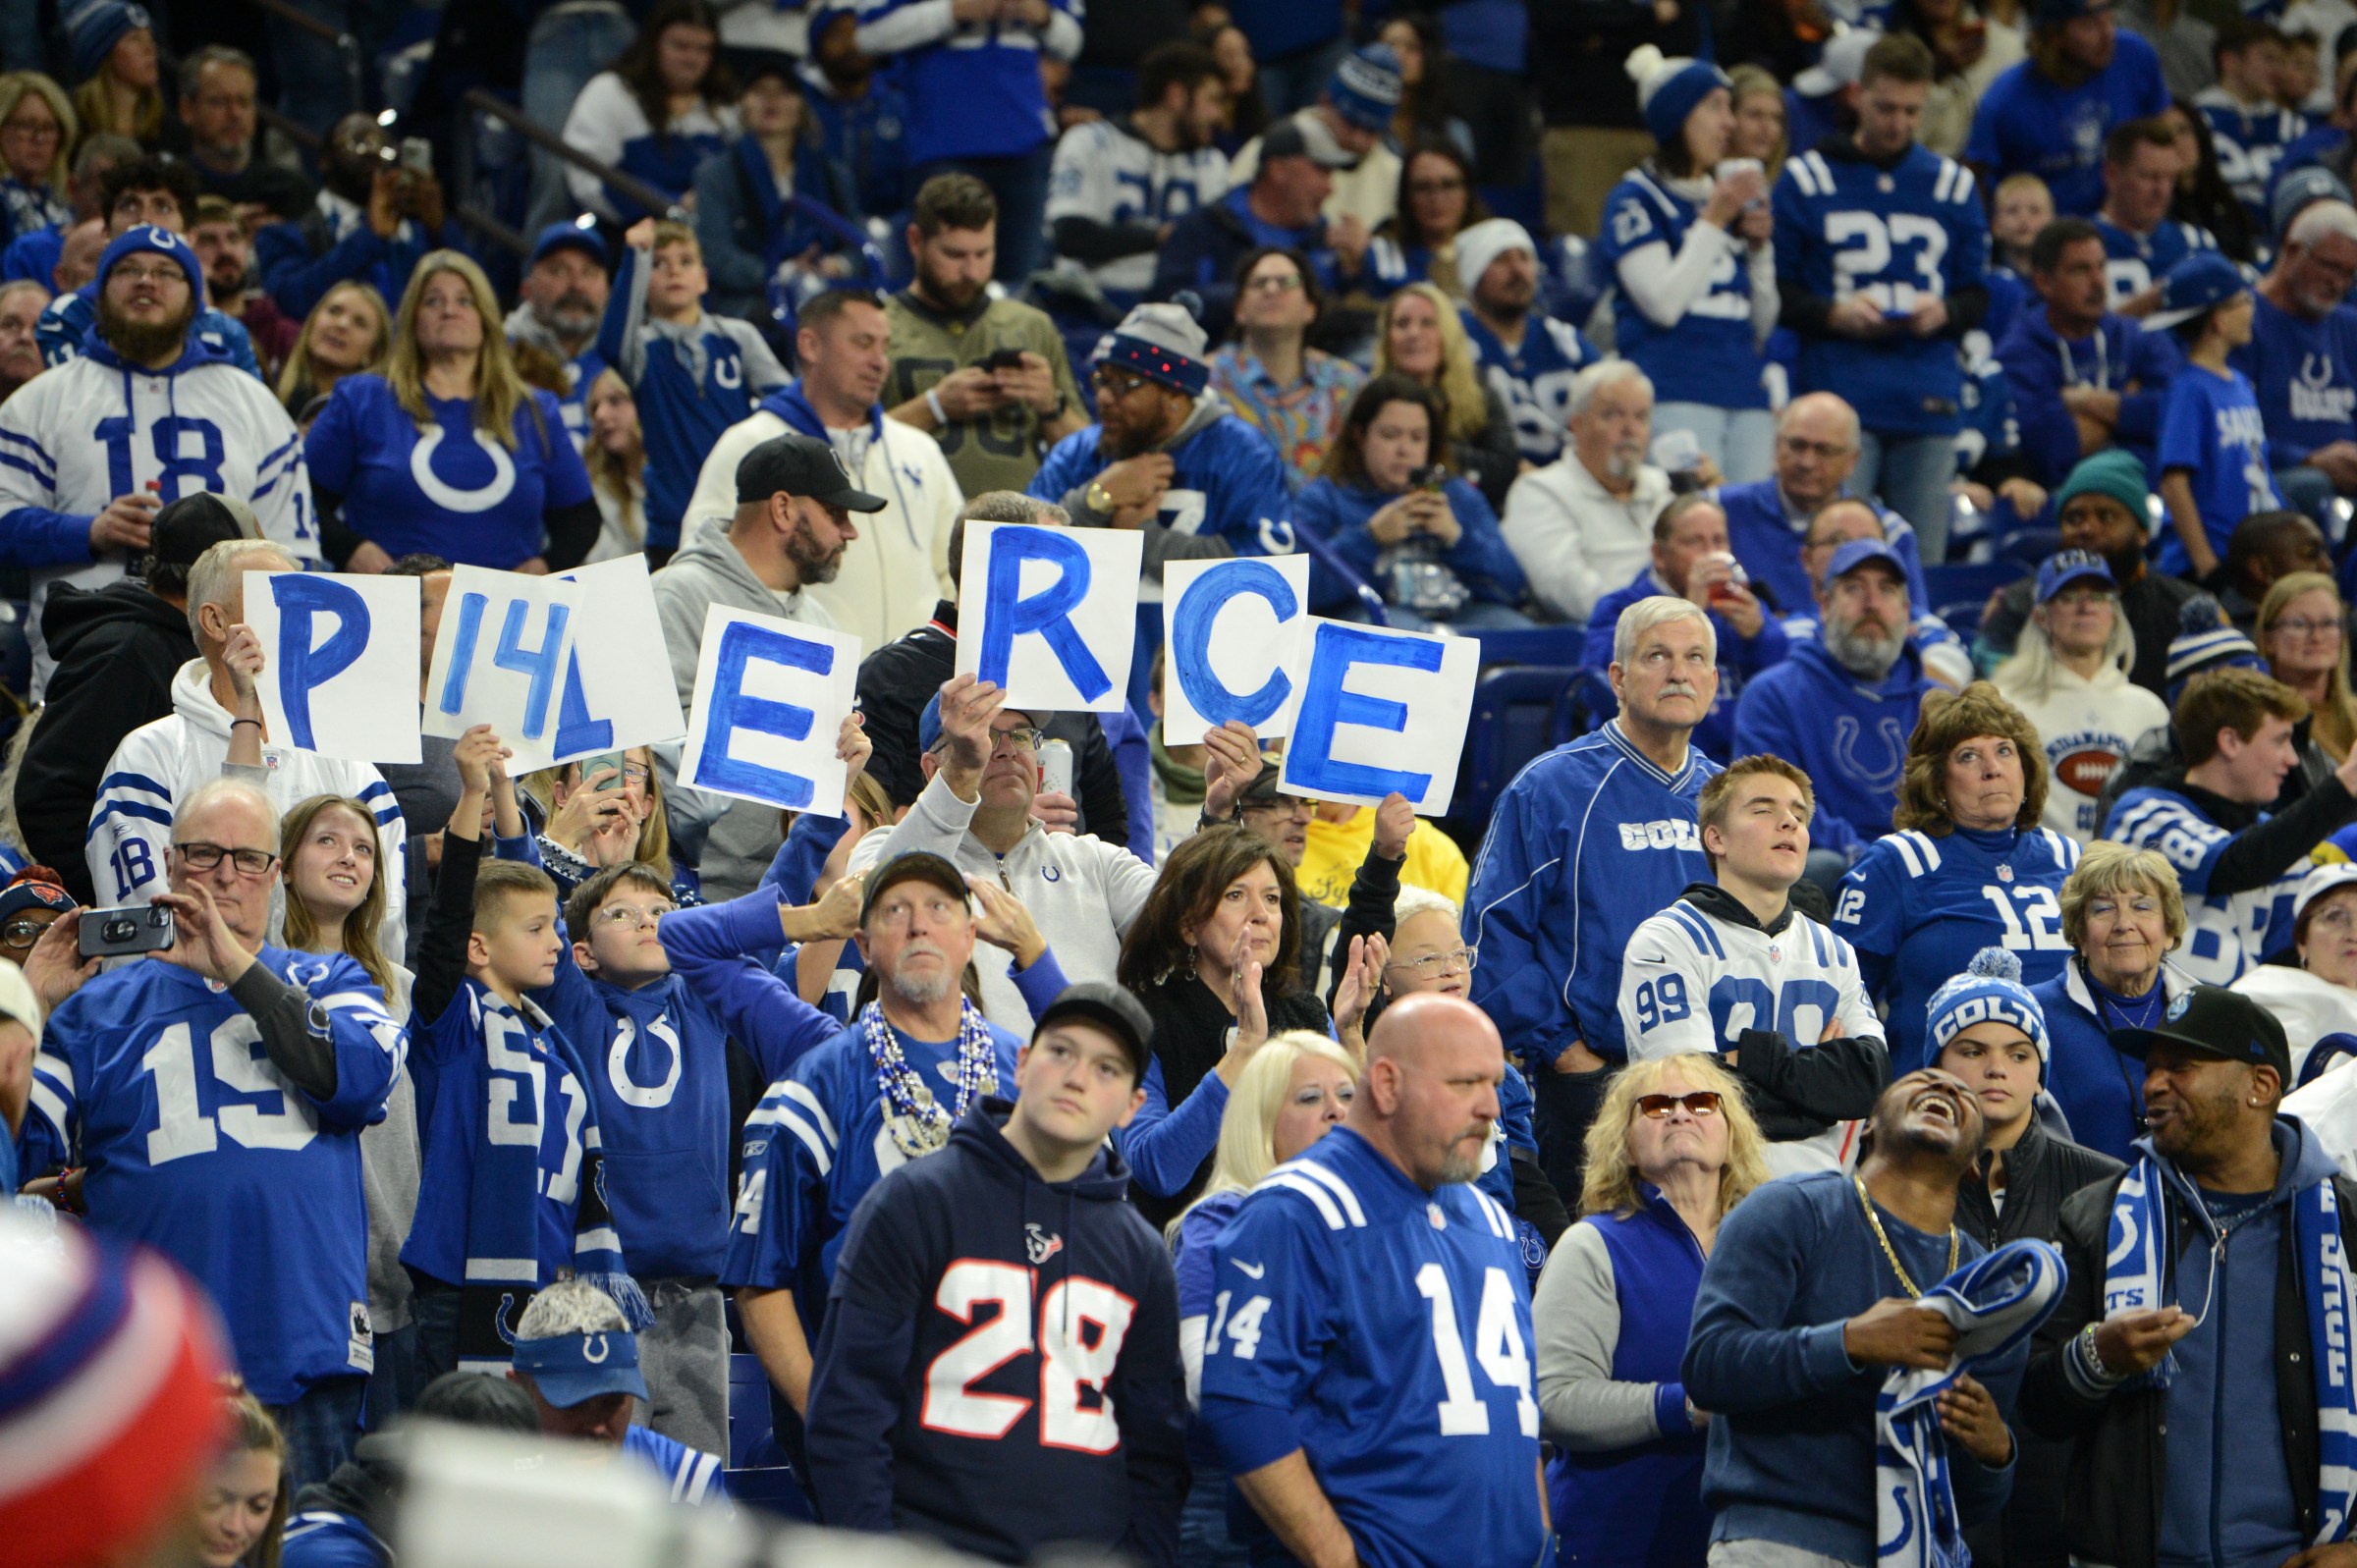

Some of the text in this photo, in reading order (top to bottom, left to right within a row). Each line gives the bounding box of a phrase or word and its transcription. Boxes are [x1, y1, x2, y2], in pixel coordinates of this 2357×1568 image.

[1824, 210, 1948, 312] 23
[269, 574, 370, 751] P
[440, 592, 570, 740] 14
[693, 621, 833, 809] E
[978, 526, 1113, 704] R
[1173, 559, 1299, 728] C
[1286, 622, 1445, 804] E
[1618, 818, 1704, 851] COL
[110, 837, 157, 902] 18
[1833, 887, 1866, 925] 12
[1982, 885, 2075, 950] 12
[1636, 972, 1691, 1036] 99
[1932, 995, 2051, 1063] COLTS
[919, 1257, 1138, 1456] 28
[1204, 1289, 1272, 1360] 14
[1414, 1263, 1540, 1437] 14
